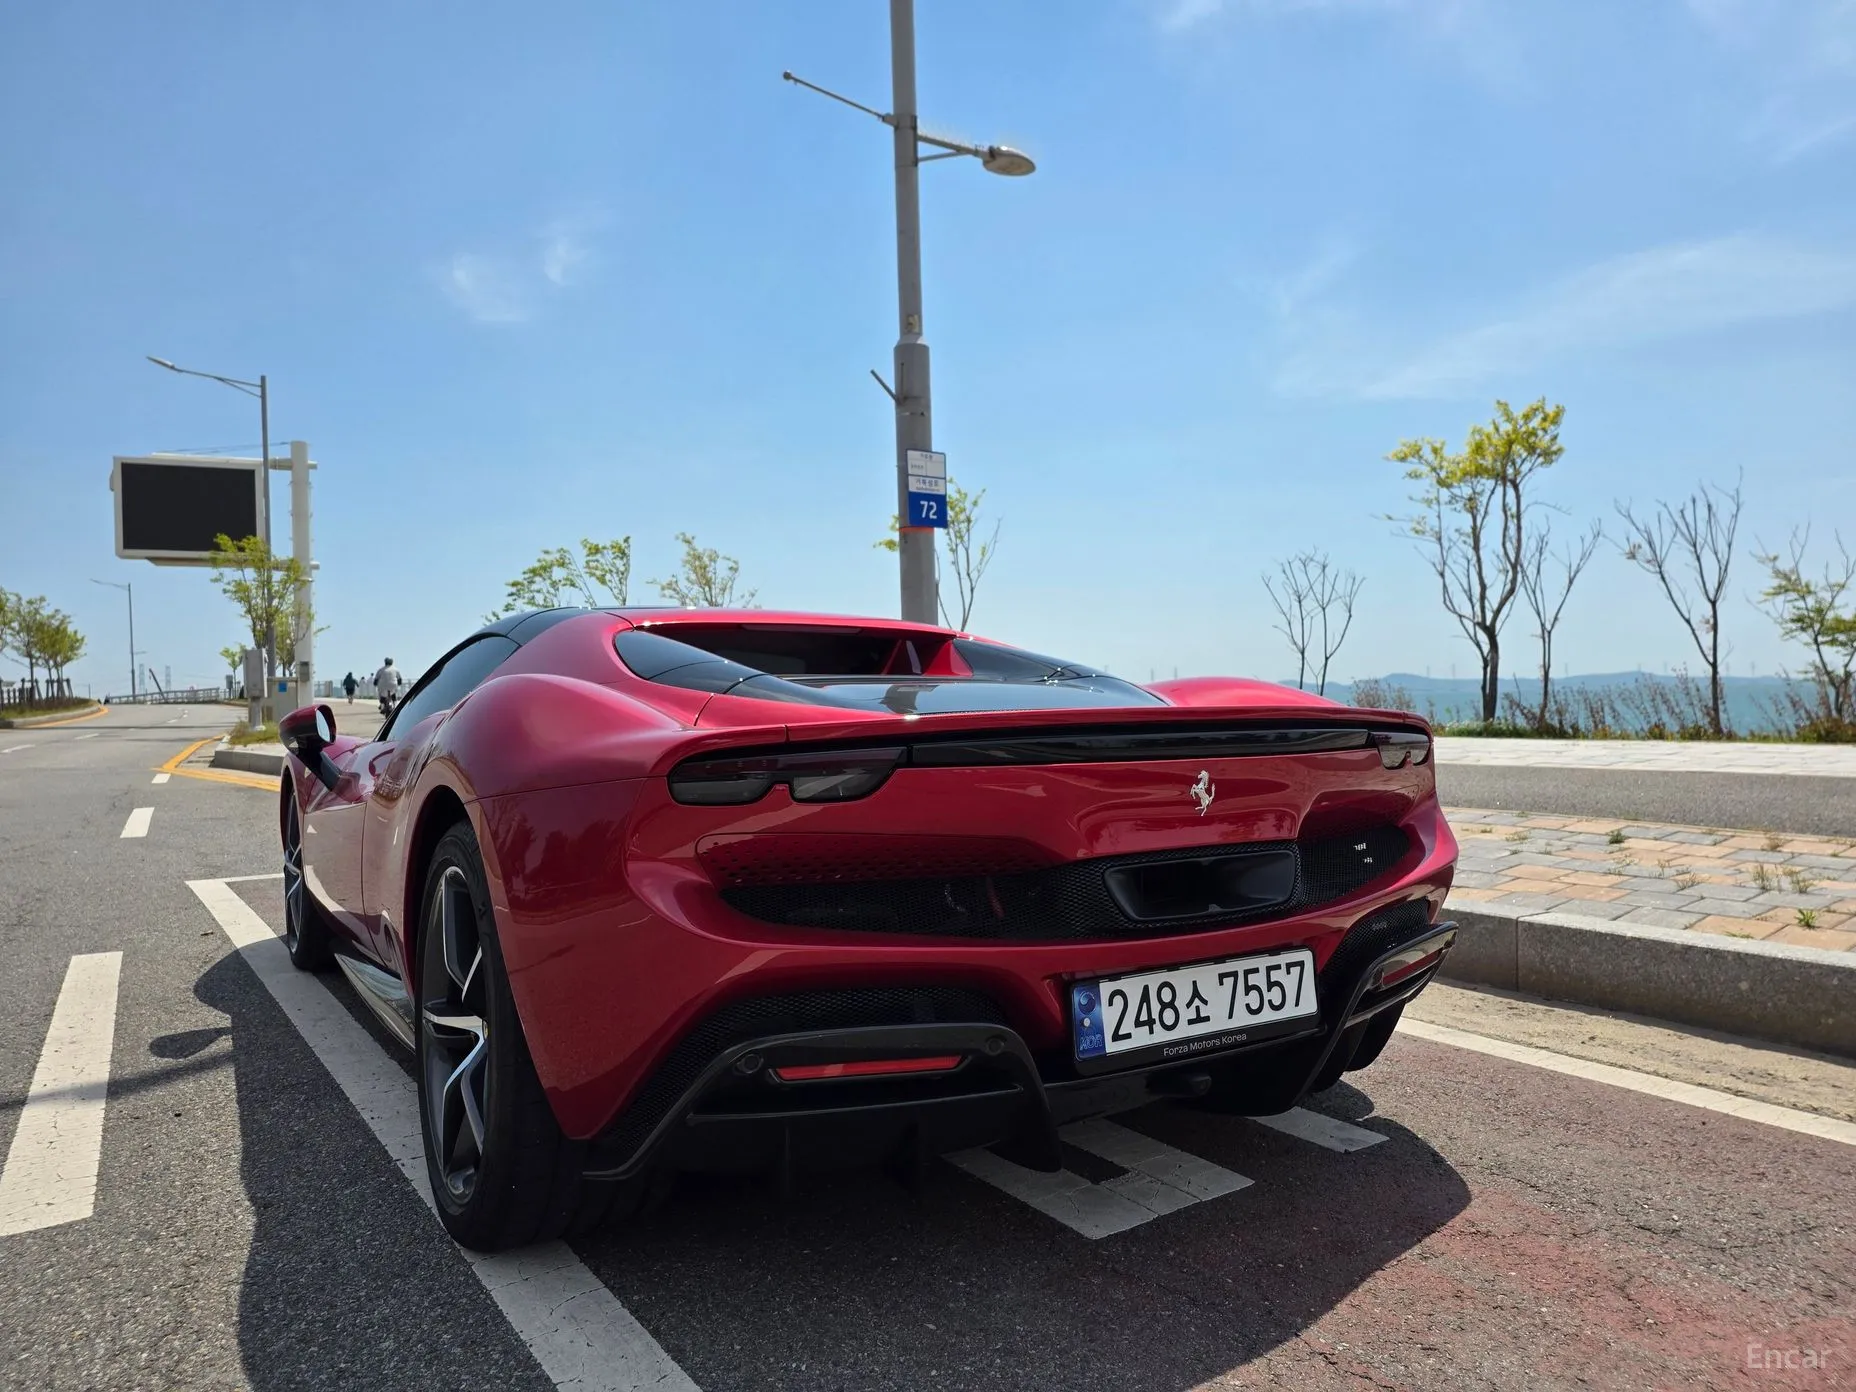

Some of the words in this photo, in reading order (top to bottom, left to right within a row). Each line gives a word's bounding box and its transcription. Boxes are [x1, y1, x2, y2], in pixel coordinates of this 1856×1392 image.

[920, 500, 937, 519] 72
[1108, 980, 1210, 1042] 248소
[1217, 960, 1305, 1020] 7557
[1163, 1046, 1189, 1057] Forza
[1189, 1038, 1221, 1051] Motors
[1221, 1032, 1247, 1045] Korea
